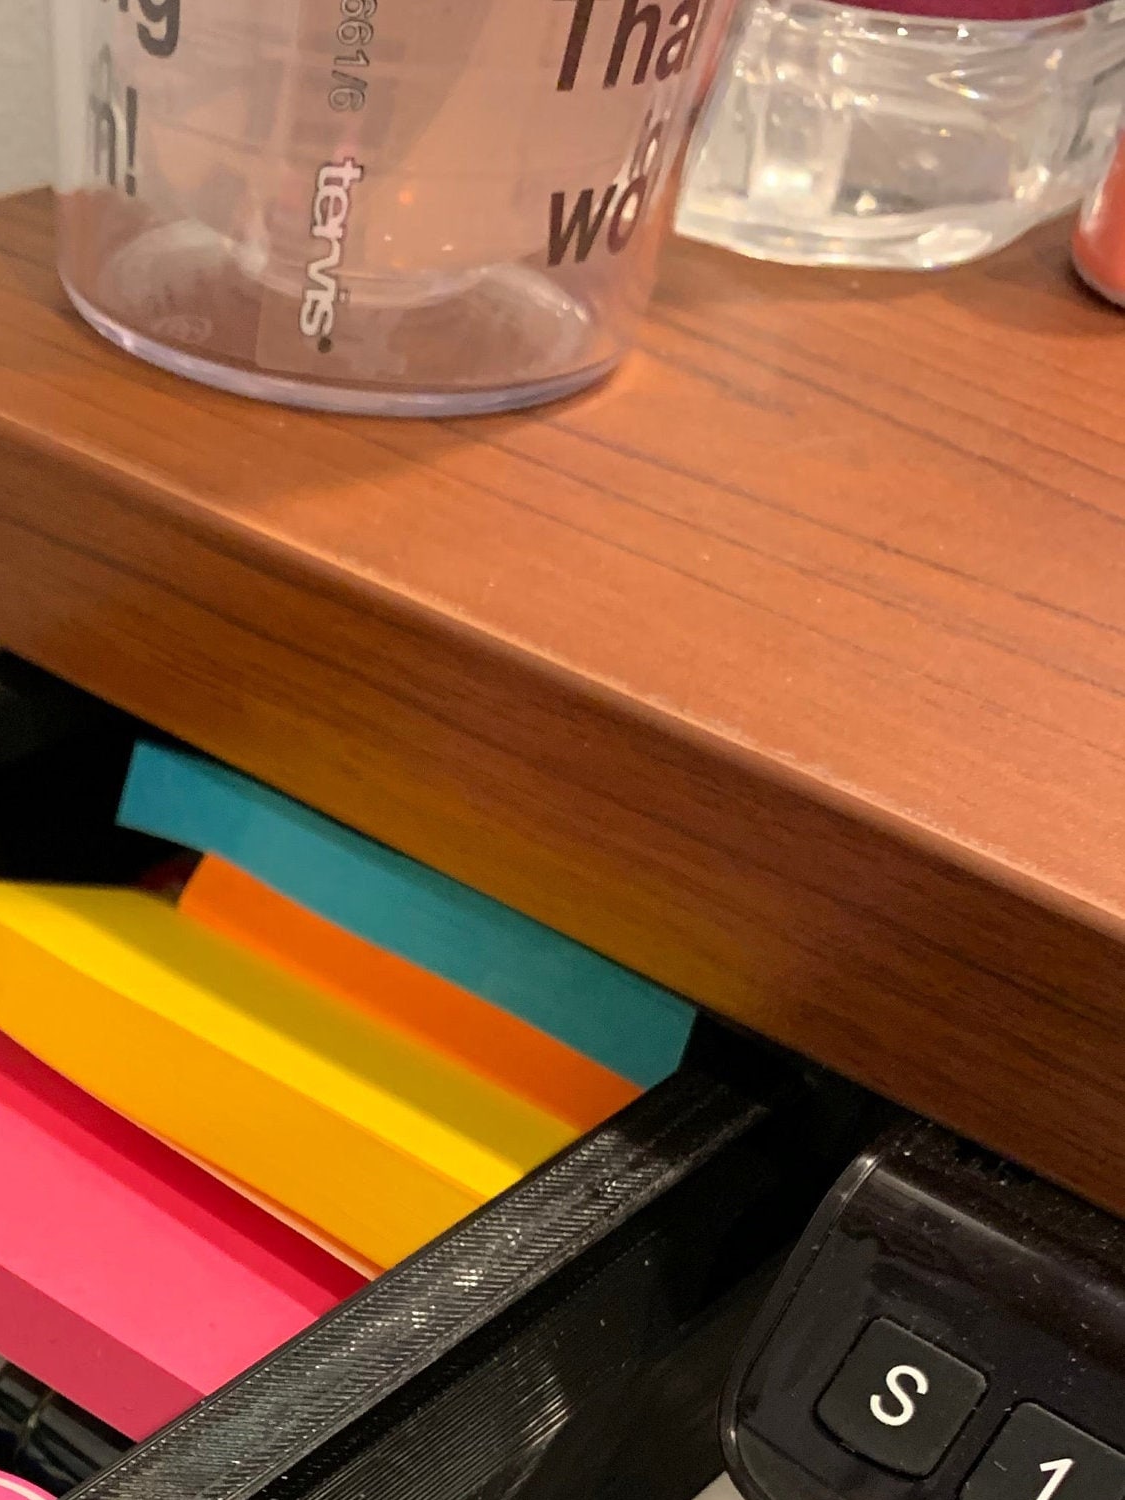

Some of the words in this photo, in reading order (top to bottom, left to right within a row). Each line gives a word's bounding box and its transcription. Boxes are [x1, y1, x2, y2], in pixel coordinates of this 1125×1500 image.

[551, 0, 705, 92] Tha
[299, 156, 364, 340] tervis
[870, 1364, 928, 1427] S
